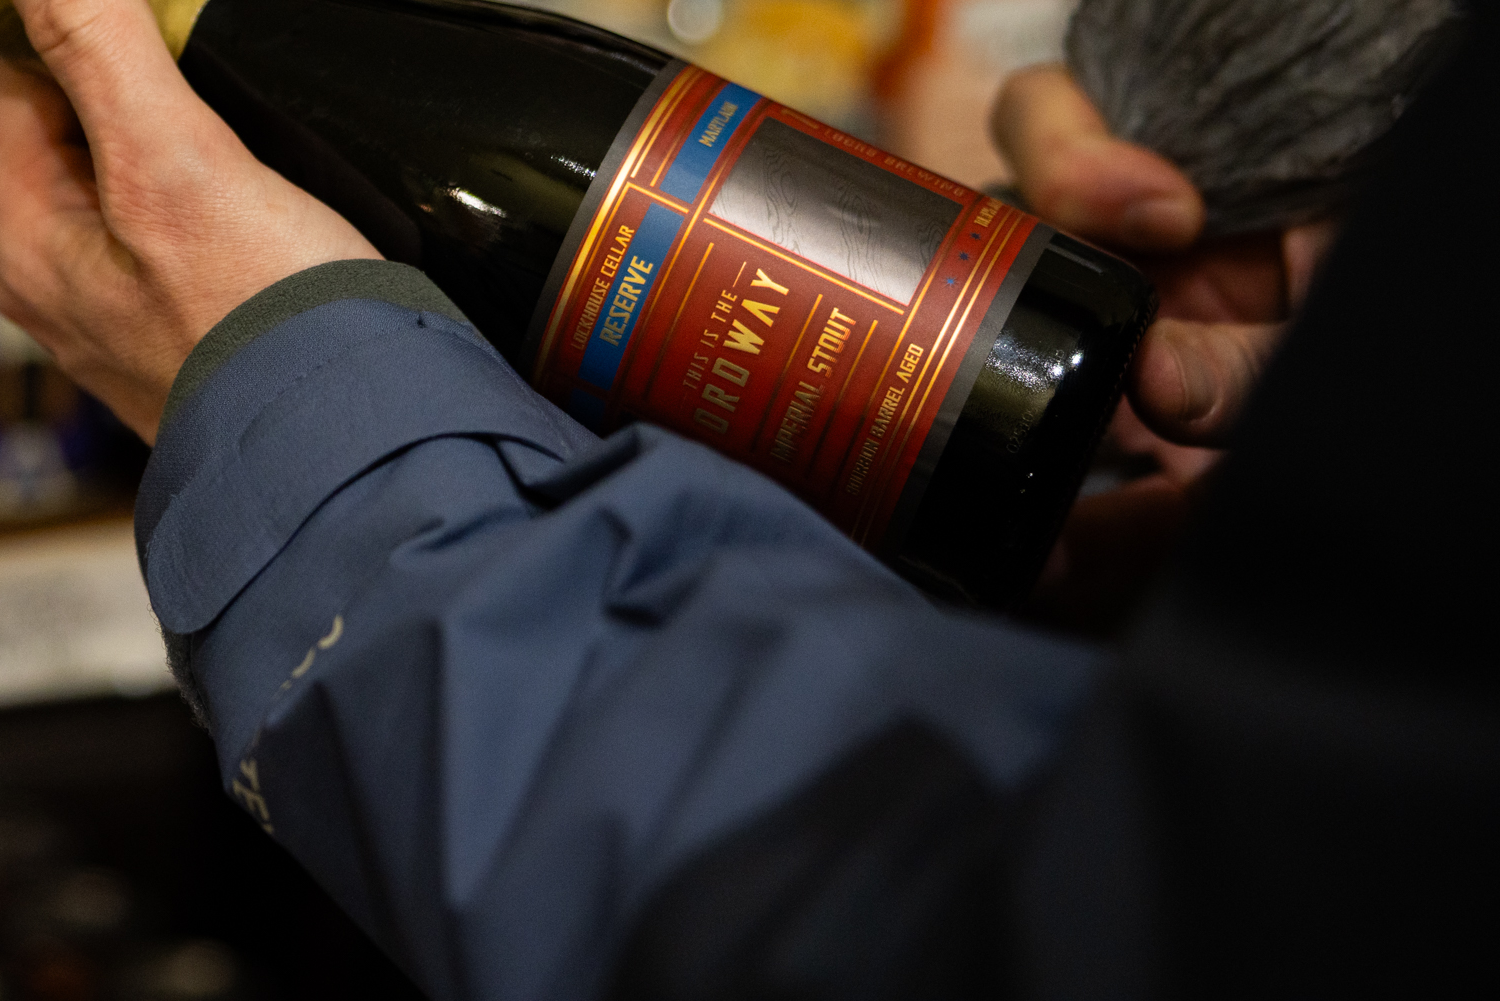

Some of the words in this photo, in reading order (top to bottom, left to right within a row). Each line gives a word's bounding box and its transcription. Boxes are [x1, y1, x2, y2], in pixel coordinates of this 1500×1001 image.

[570, 276, 611, 351] LOCKHOUSE
[600, 224, 635, 278] CELLAR
[599, 255, 655, 347] RESERVE
[682, 352, 710, 390] THIS
[700, 328, 719, 348] IS
[711, 289, 738, 323] THE
[693, 267, 790, 435] ORDWAY
[770, 380, 825, 464] IMPERIAL
[806, 306, 857, 378] STOUT
[846, 437, 881, 496] BOURBON
[869, 386, 906, 439] BARREL
[895, 343, 925, 384] AGED
